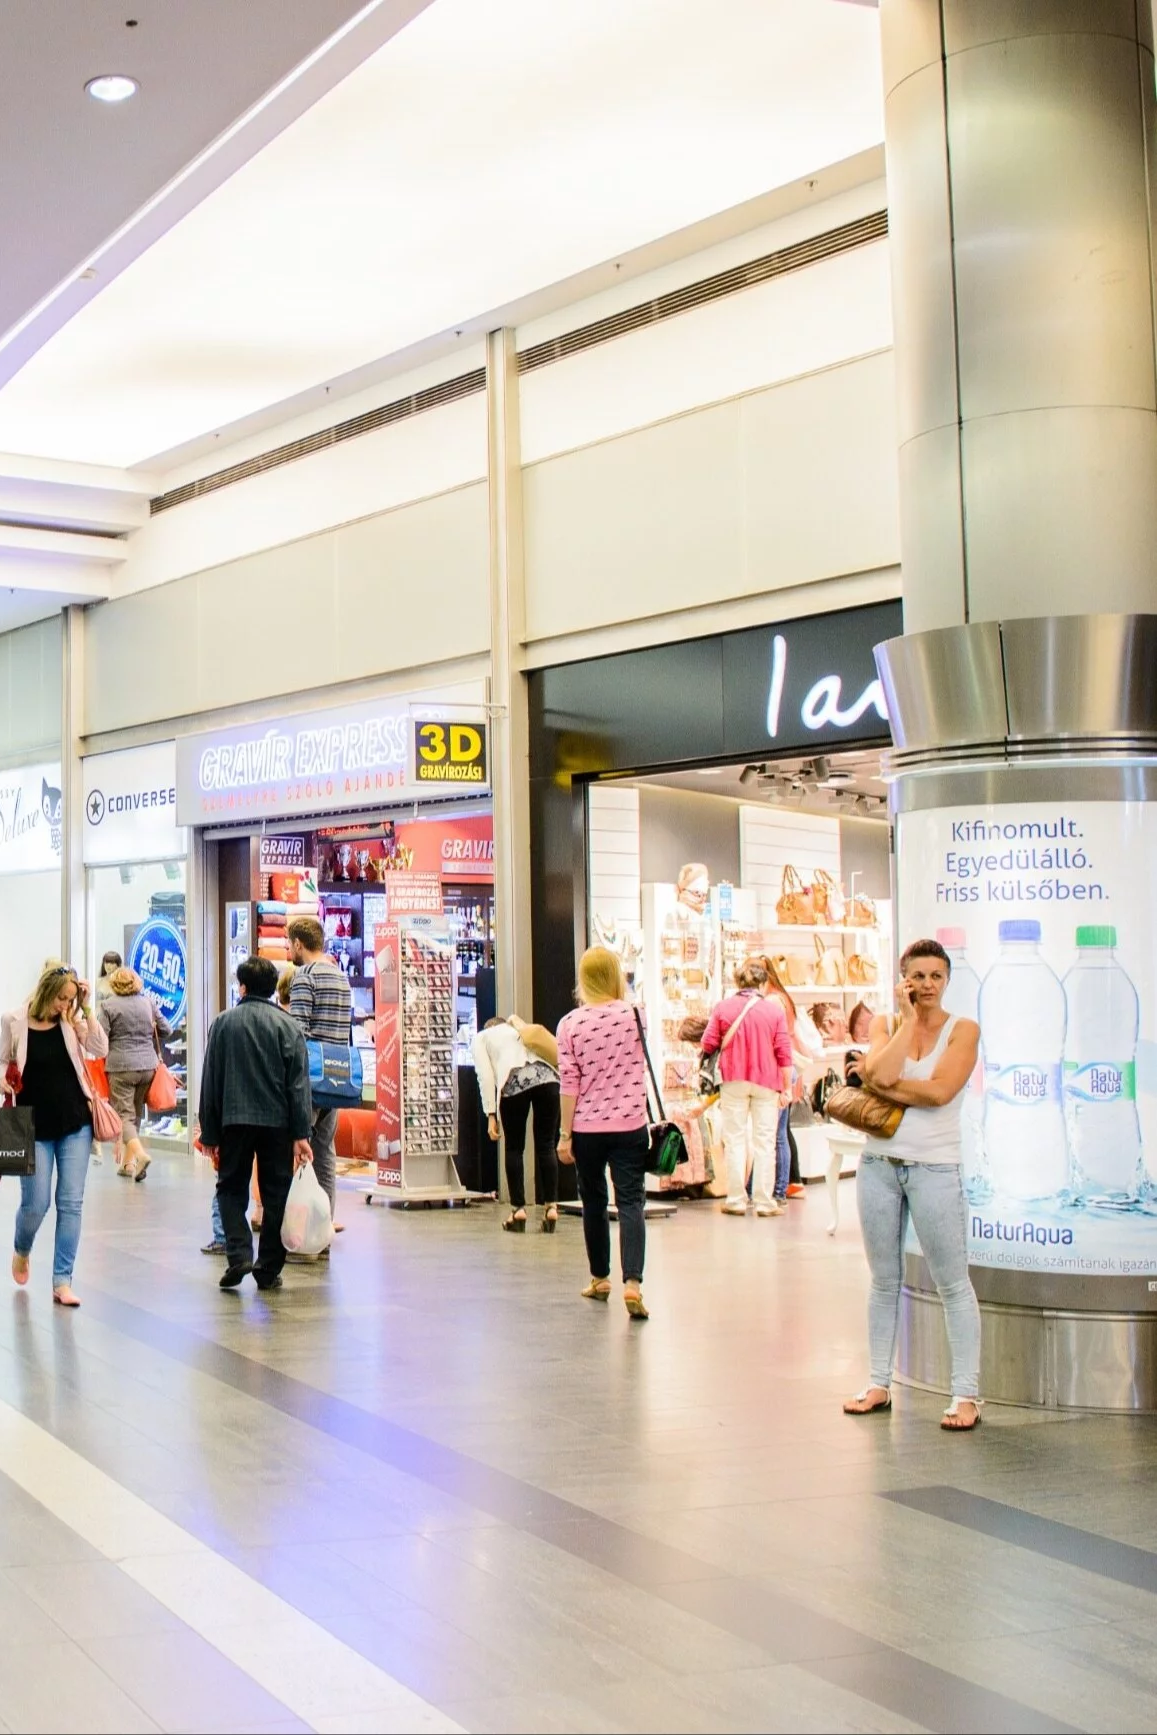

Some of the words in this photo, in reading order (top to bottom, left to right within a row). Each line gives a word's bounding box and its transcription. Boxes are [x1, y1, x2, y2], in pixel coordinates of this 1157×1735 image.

[199, 728, 293, 791] GRAVÍR
[294, 716, 411, 776] EXPRESS
[419, 723, 481, 762] 3D
[419, 762, 482, 780] GRAVÍROZÁS!
[287, 776, 334, 800] SZÓLÓ
[344, 766, 405, 793] AJÁNDÉ
[108, 788, 176, 813] CONVERSE
[952, 817, 1084, 842] Kifinomult.
[261, 837, 302, 855] GRAVÍR
[261, 855, 303, 865] EXPRESSZ
[946, 848, 1093, 878] Egyedülálló.
[936, 882, 979, 903] Friss
[987, 879, 1110, 901] külsőben.
[1013, 1071, 1048, 1085] Natur
[1091, 1068, 1123, 1082] Natur
[1013, 1083, 1047, 1098] Aqua
[1091, 1080, 1122, 1094] Aqua
[972, 1216, 1074, 1246] NaturAqua
[996, 1250, 1040, 1267] dolgok
[1044, 1254, 1116, 1270] számítanak
